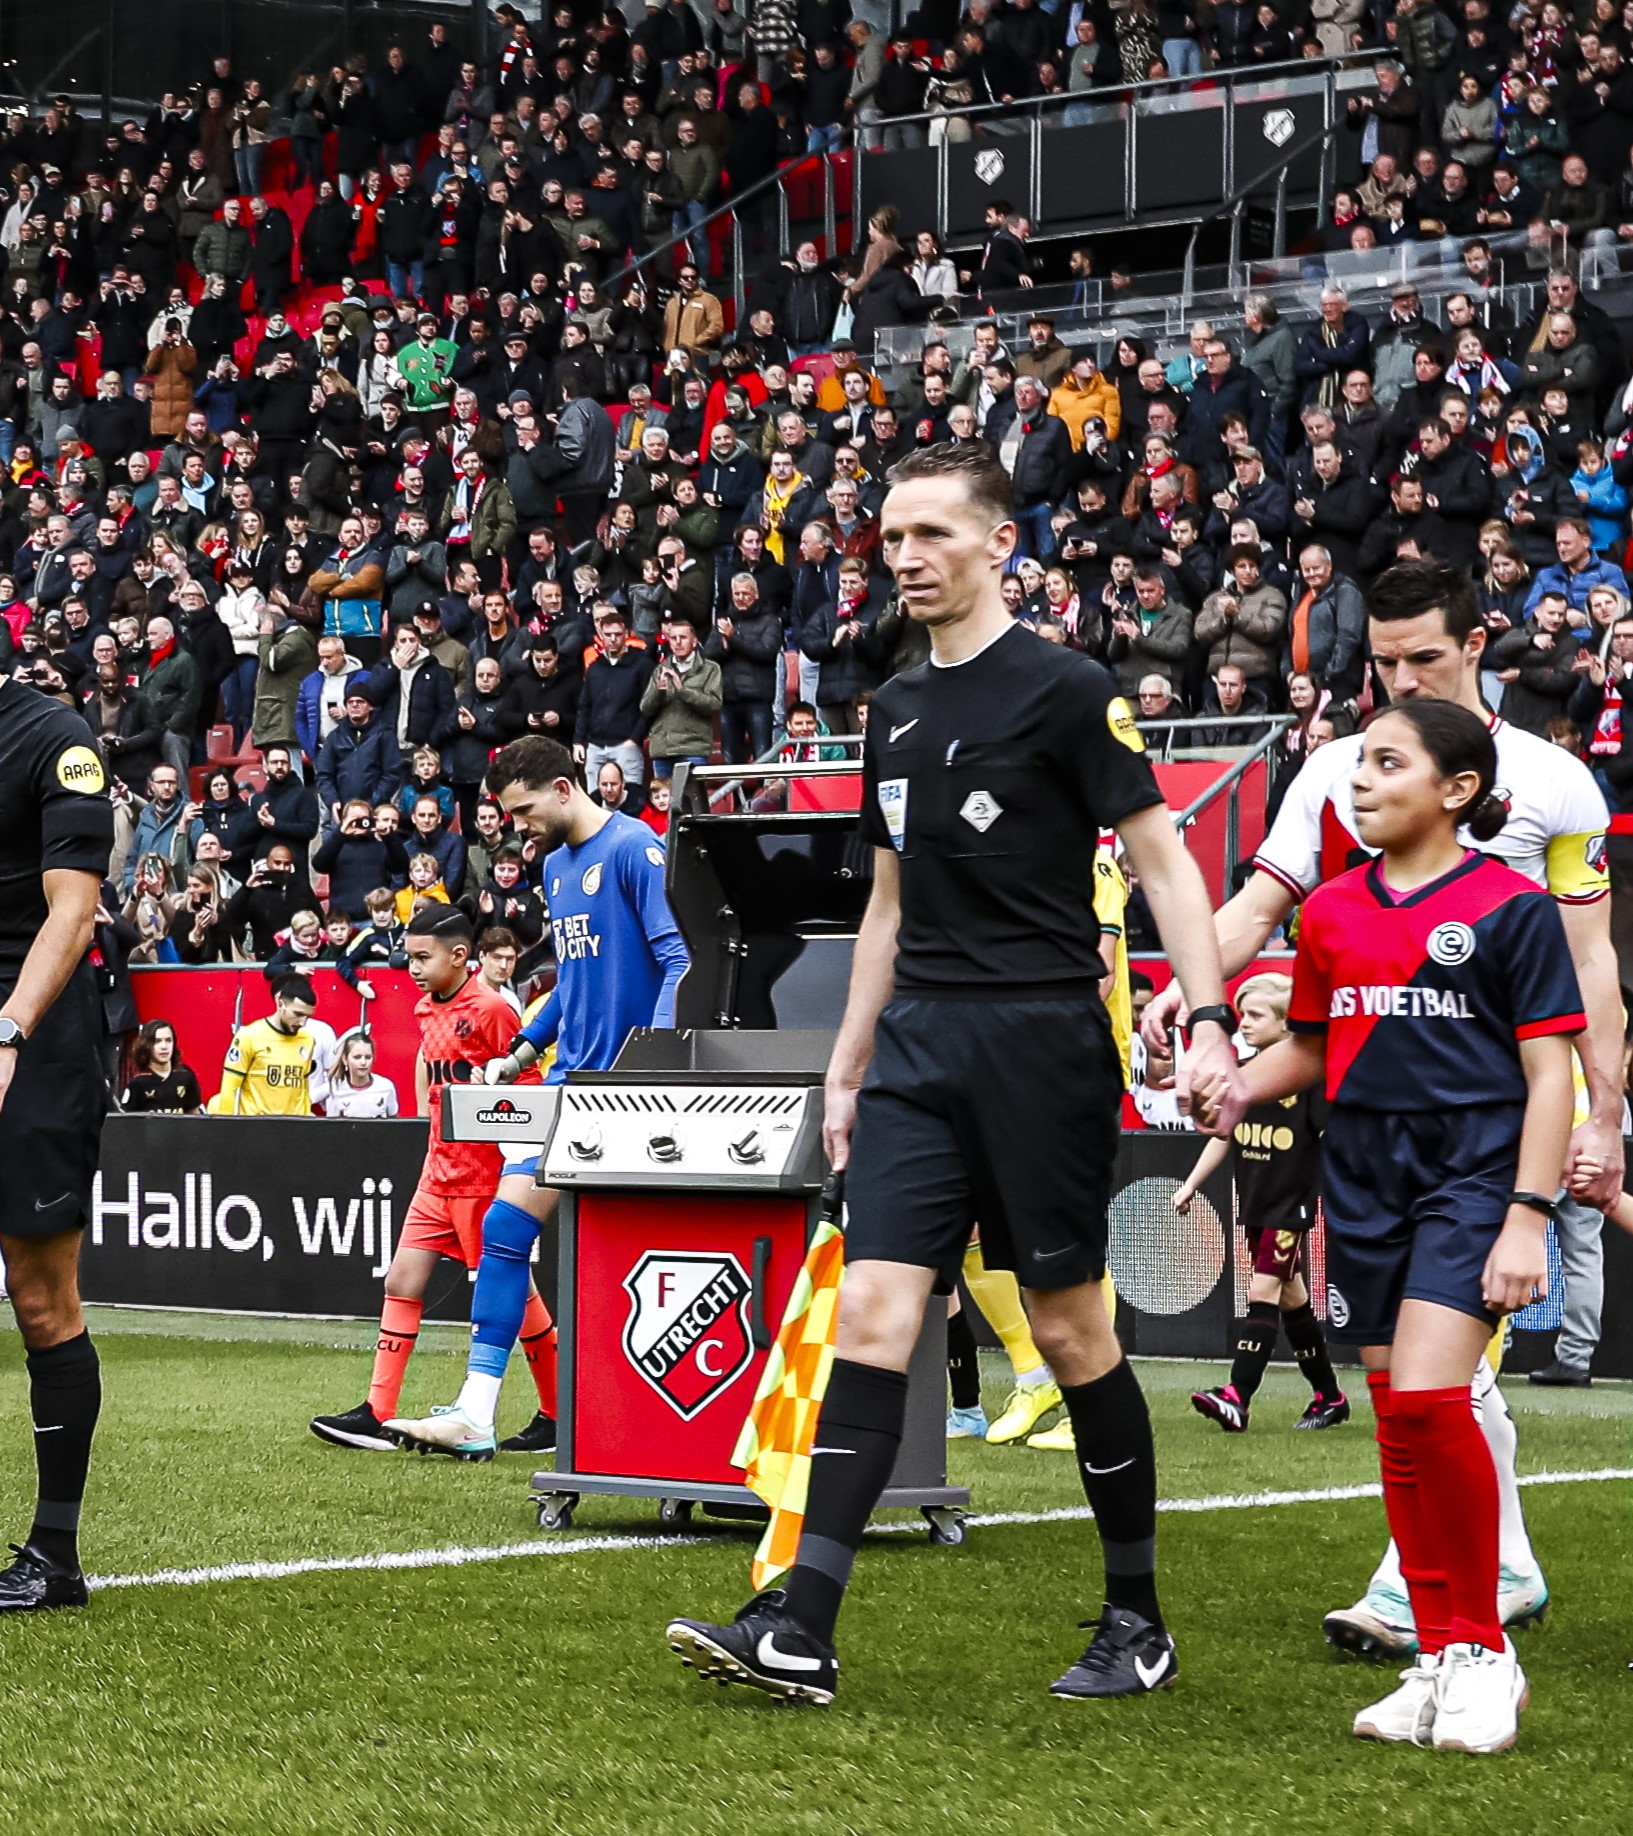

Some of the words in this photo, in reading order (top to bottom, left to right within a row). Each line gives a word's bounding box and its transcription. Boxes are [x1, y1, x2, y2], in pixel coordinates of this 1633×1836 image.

[62, 762, 101, 781] ARAG
[565, 914, 590, 938] BET
[567, 933, 601, 961] CITY
[1359, 986, 1475, 1018] VOETBAL
[478, 1110, 531, 1124] NAPOLEON
[92, 1170, 275, 1262] Hallo,
[292, 1177, 394, 1278] wij
[657, 1272, 676, 1308] F
[642, 1268, 741, 1379] UTRECHT
[695, 1339, 723, 1377] C
